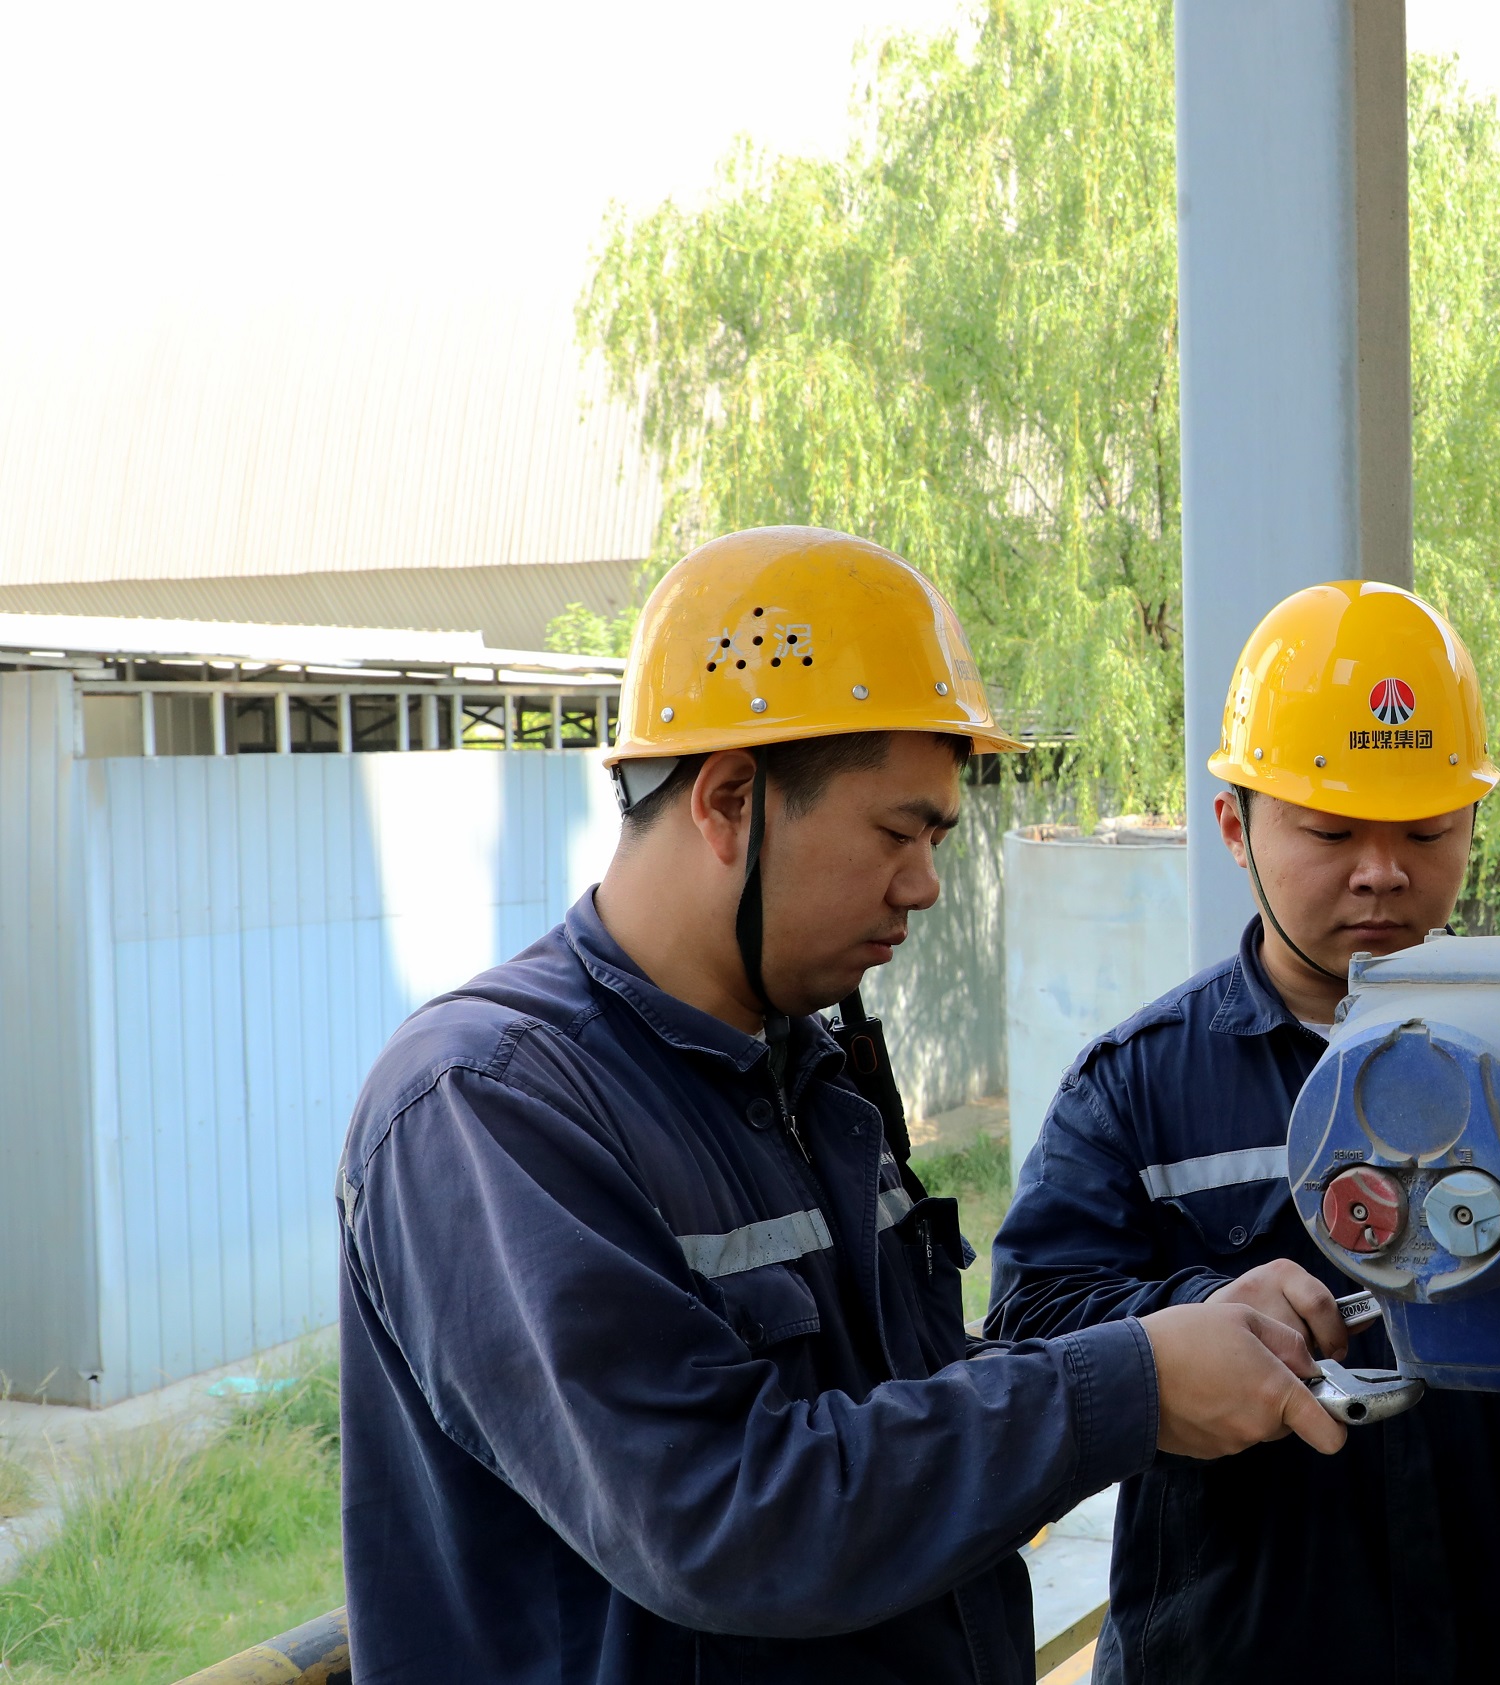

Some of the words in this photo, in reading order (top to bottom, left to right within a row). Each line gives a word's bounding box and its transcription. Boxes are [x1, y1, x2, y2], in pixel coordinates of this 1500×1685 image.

[706, 623, 813, 663] 水泥
[1349, 729, 1433, 750] 陕煤集团
[1333, 1149, 1364, 1160] REMOTE
[1303, 1181, 1321, 1191] STOP
